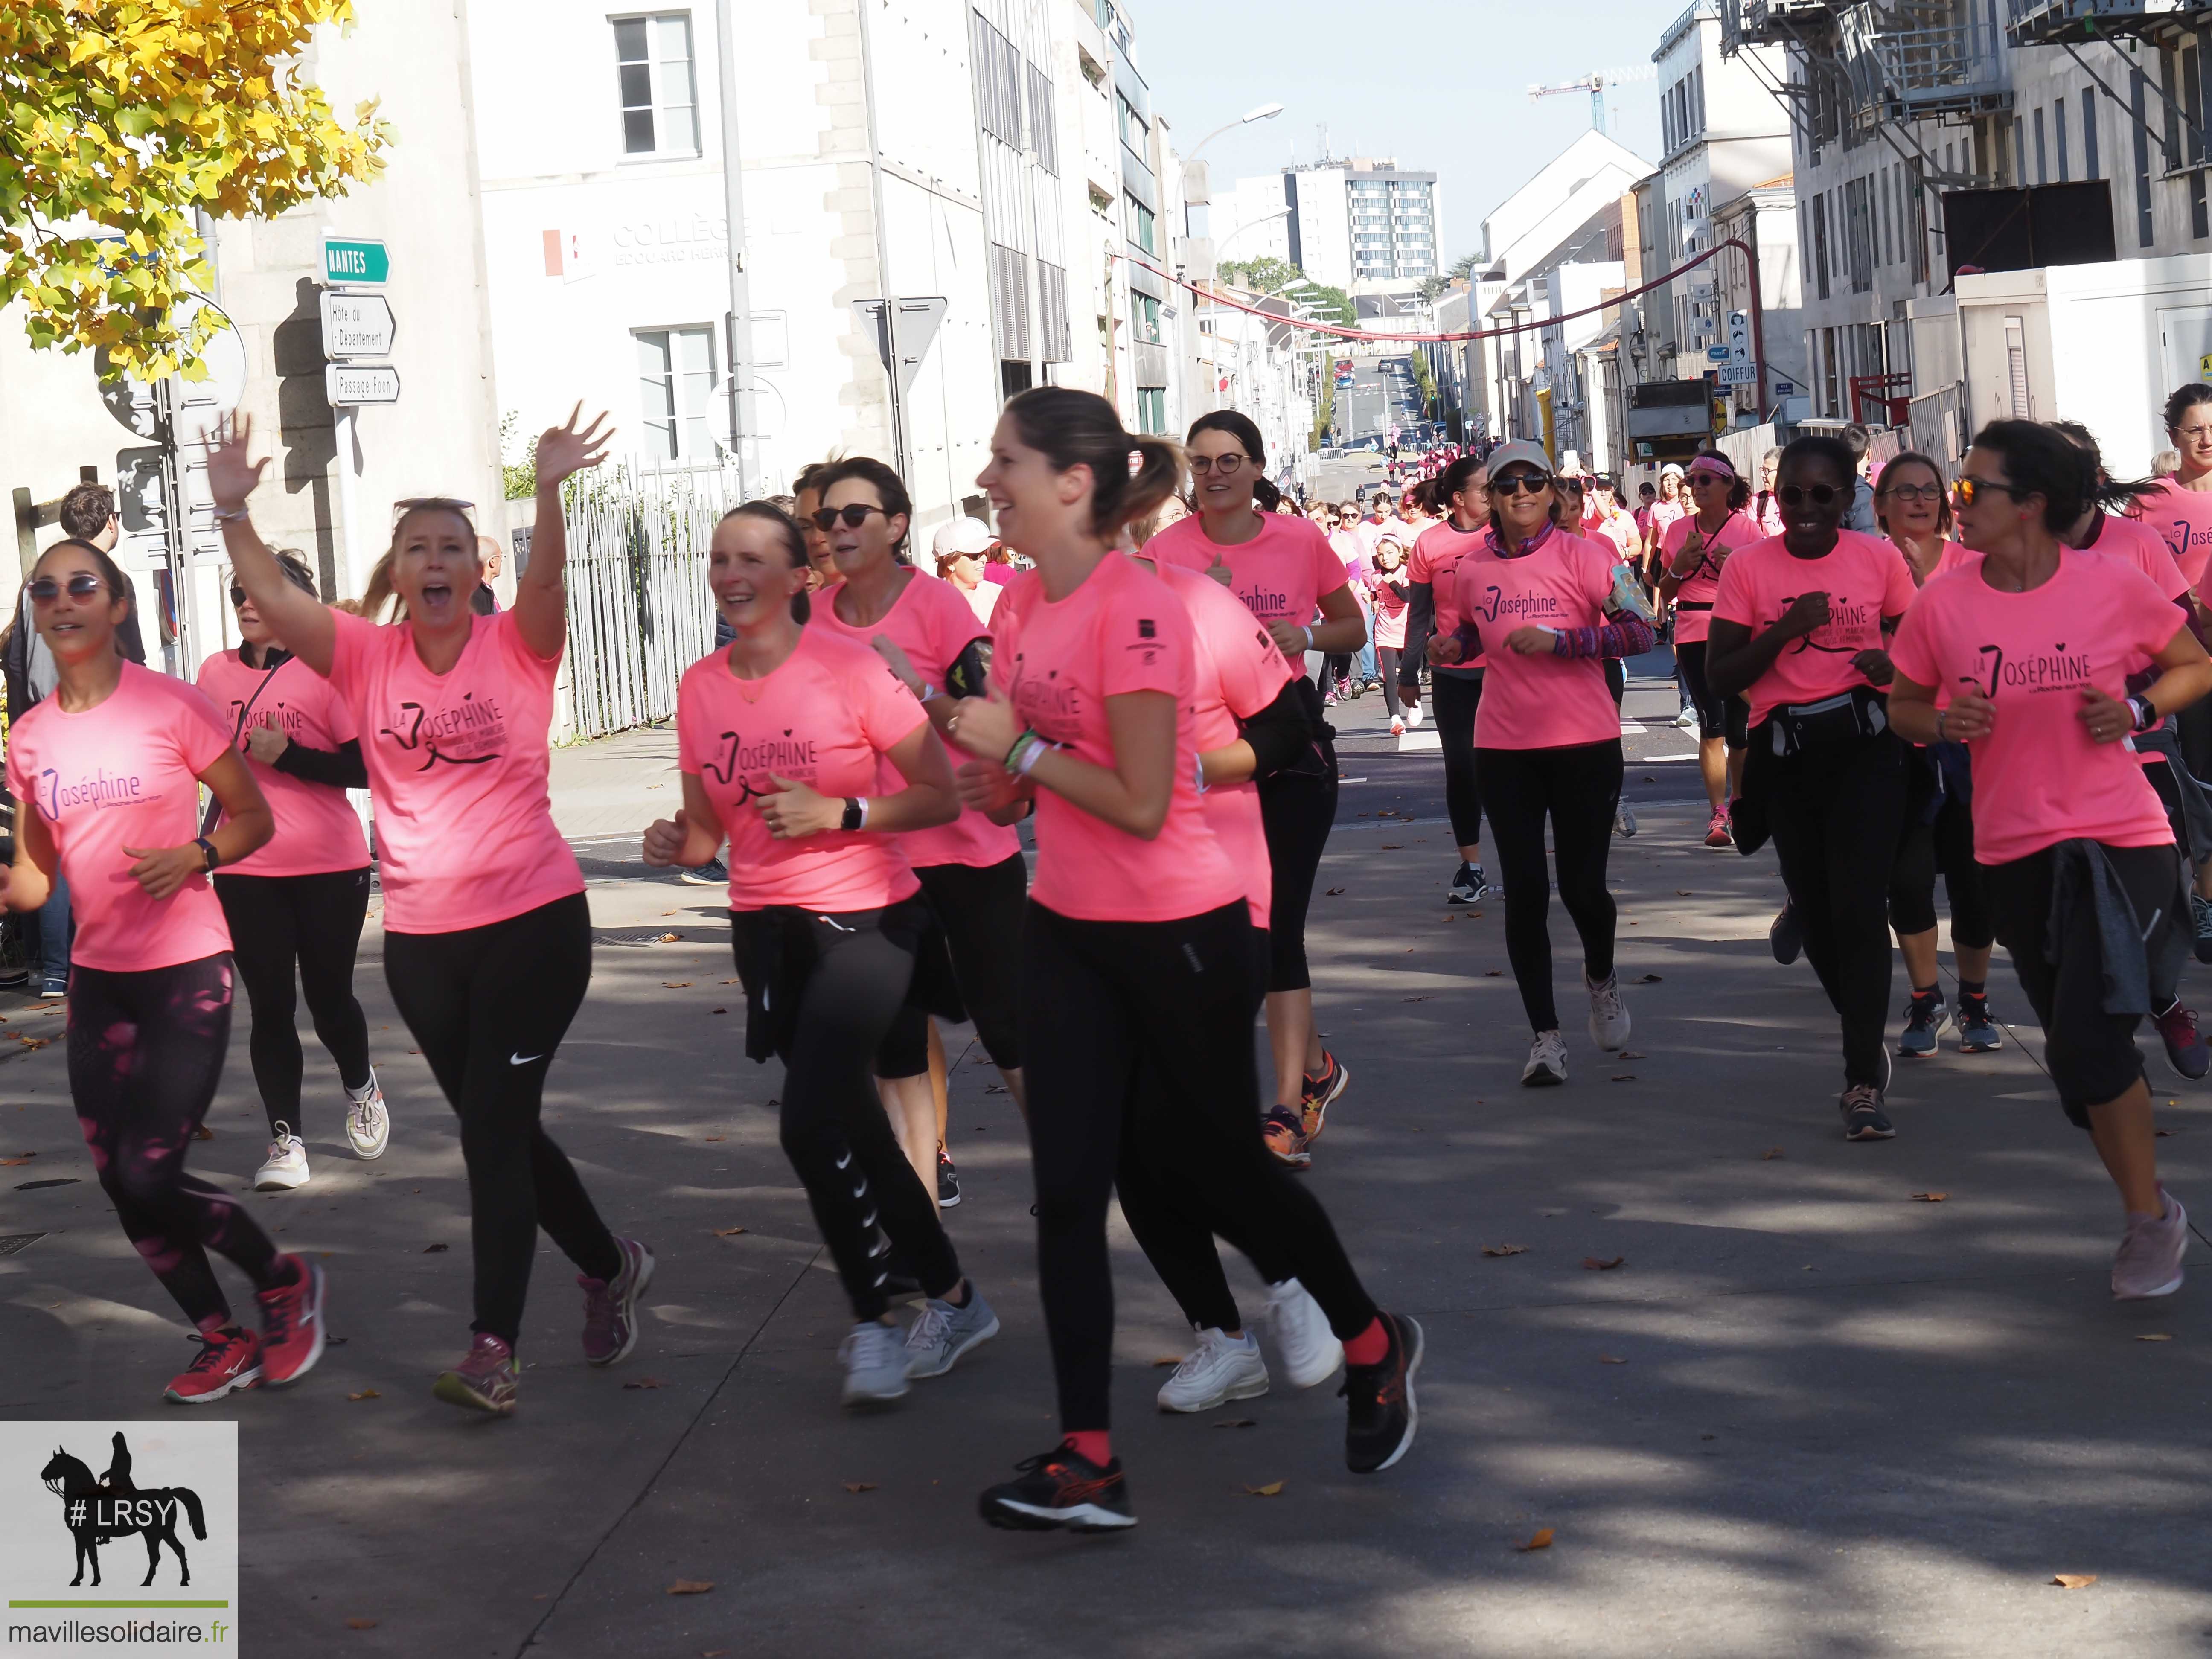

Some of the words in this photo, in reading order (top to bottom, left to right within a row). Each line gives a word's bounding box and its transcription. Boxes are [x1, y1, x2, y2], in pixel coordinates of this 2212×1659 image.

[614, 212, 752, 247] COLLÈG
[328, 249, 366, 274] NANTES
[333, 304, 350, 322] Hôtel
[352, 305, 360, 322] du
[339, 329, 382, 350] Département
[1722, 366, 1755, 381] COIFFUR
[340, 376, 370, 398] Passage
[373, 376, 390, 393] Foch
[2170, 529, 2181, 538] la
[1239, 585, 1286, 611] éphine
[1475, 585, 1557, 622] Joséphine
[1483, 595, 1492, 605] la
[1959, 645, 2090, 699] JOSÉPHINE
[1973, 658, 1985, 674] LA
[227, 708, 234, 720] LA
[381, 698, 504, 750] JOSÉPHINE
[393, 713, 406, 728] LA
[703, 731, 818, 784] JOSÉPHINE
[34, 768, 140, 821] Joséphine
